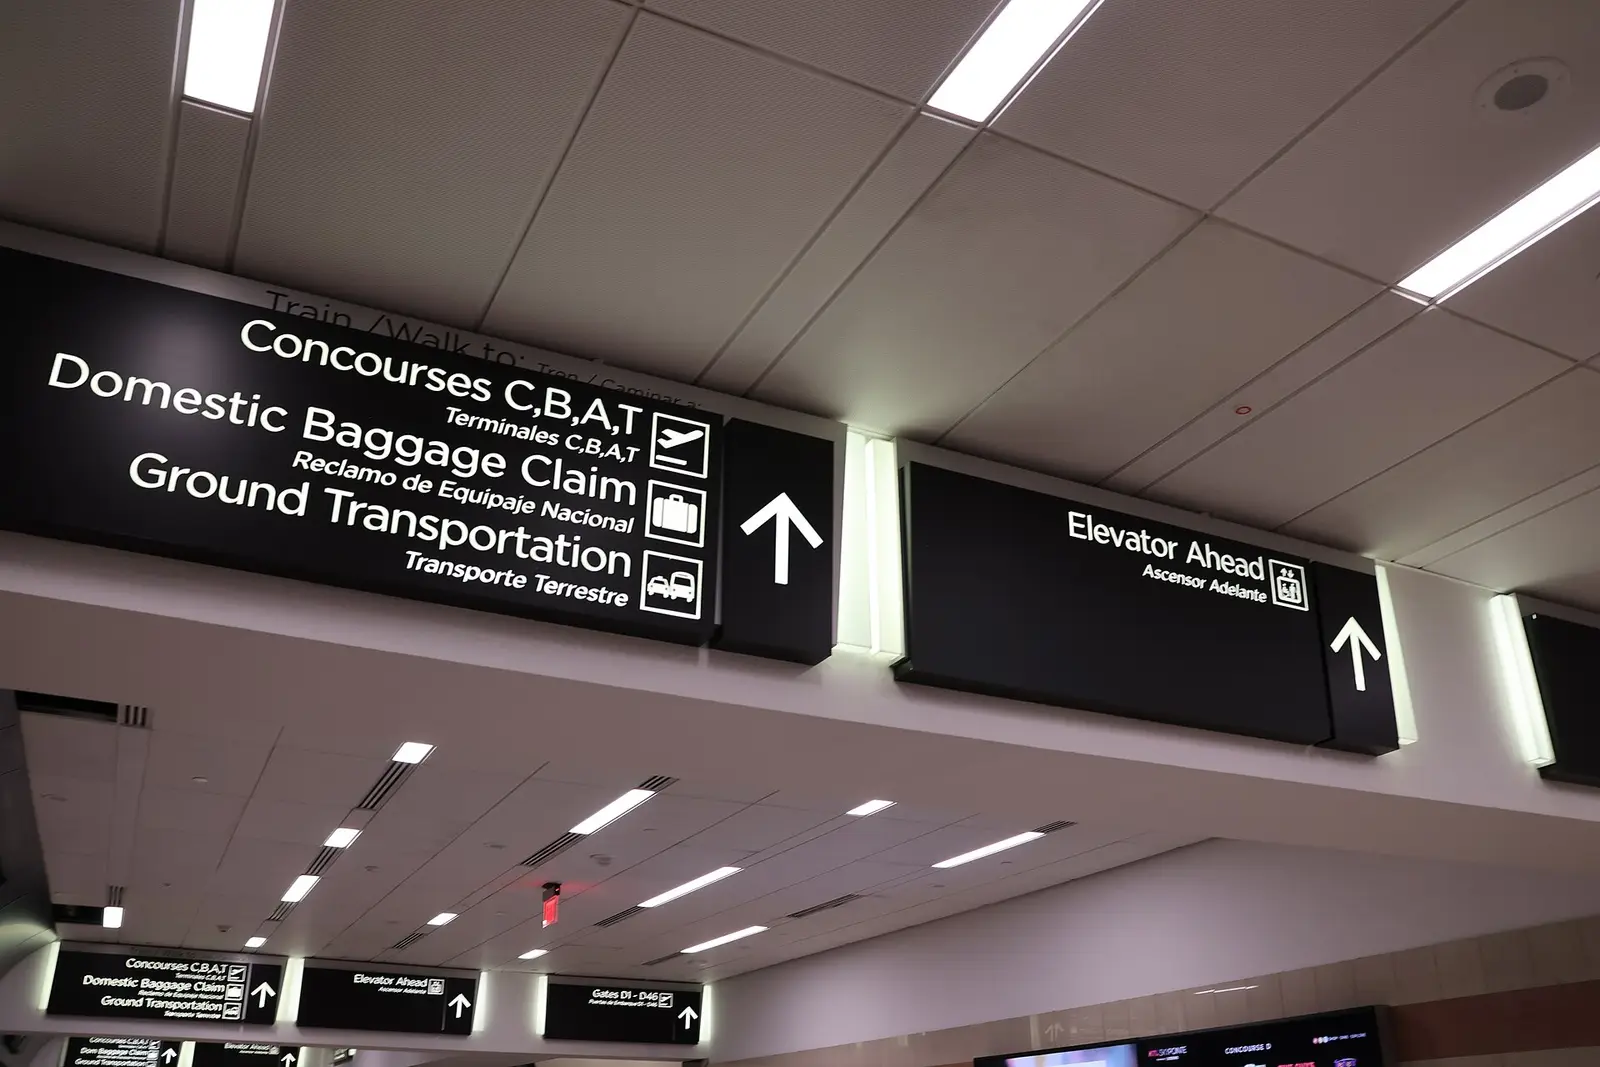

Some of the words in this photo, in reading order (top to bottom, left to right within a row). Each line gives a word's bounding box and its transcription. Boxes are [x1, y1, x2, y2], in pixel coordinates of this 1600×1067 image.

[240, 319, 492, 402] Concourses
[504, 379, 644, 436] C,B,A,T
[48, 352, 288, 433] Domestic
[302, 406, 507, 478] Baggage
[521, 454, 637, 506] Claim
[446, 406, 560, 446] Terminales
[564, 434, 641, 464] C,B,A,T
[129, 452, 310, 517] Ground
[323, 487, 631, 578] Transportation
[292, 450, 397, 486] Reclamo
[402, 473, 433, 494] de
[437, 479, 536, 515] Equipaje
[540, 500, 635, 534] Nacional
[1067, 510, 1179, 560] Elevator
[1185, 540, 1265, 581] Ahead
[405, 550, 528, 589] Transporte
[534, 573, 629, 607] Terrestre
[1141, 563, 1208, 590] Ascensor
[1208, 578, 1268, 604] Adelante
[82, 974, 139, 988] Domestic
[140, 978, 192, 991] Baggage
[193, 981, 226, 992] Claim
[125, 957, 189, 972] Concourses
[353, 973, 395, 986] Elevator
[395, 976, 428, 988] Ahead
[101, 995, 145, 1008] Ground
[145, 997, 223, 1012] Transportation
[592, 988, 619, 999] Gates
[639, 991, 659, 1000] D46
[1224, 1043, 1265, 1055] CONCOURSE
